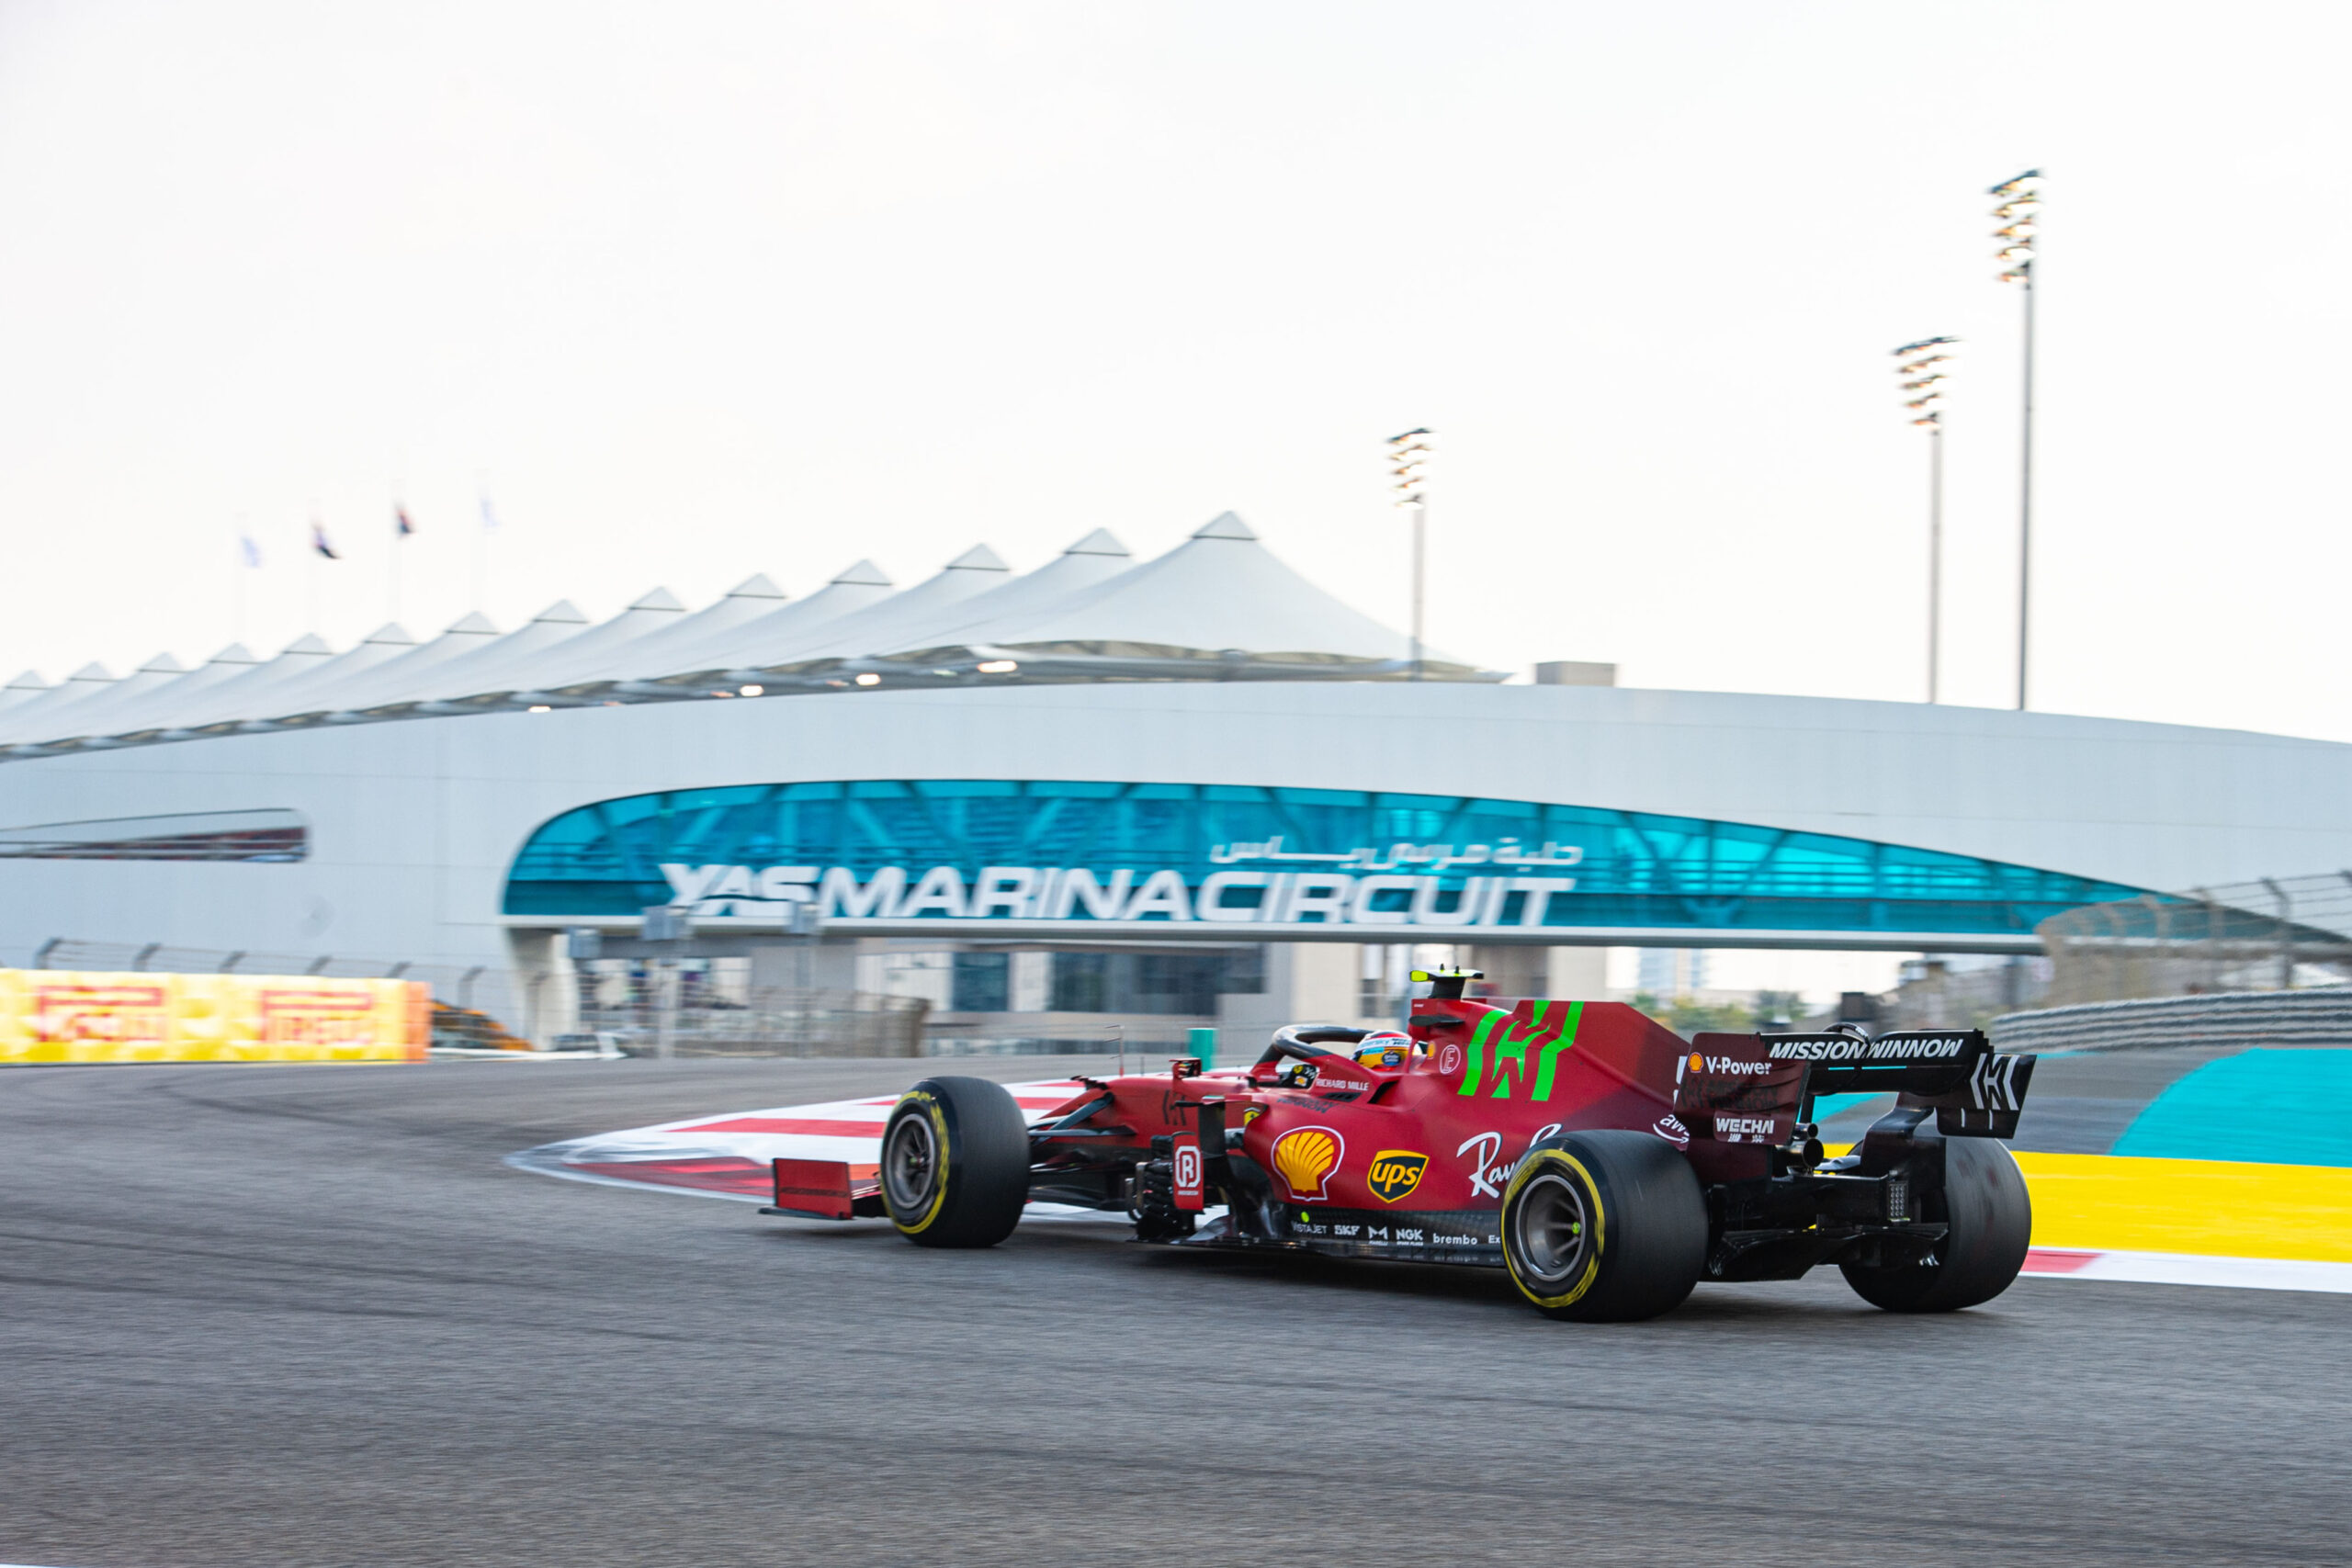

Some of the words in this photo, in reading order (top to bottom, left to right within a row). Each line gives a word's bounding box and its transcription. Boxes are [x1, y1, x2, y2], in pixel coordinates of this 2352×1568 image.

[1770, 1042, 1867, 1060] MISSION
[1866, 1039, 1963, 1058] WINNOW
[1705, 1055, 1772, 1075] V-Power
[1316, 1078, 1346, 1089] RICHARD
[1348, 1081, 1370, 1091] MILLE
[1372, 1162, 1420, 1193] ups
[1334, 1224, 1360, 1235] SKF
[1396, 1228, 1423, 1241] NGK
[1432, 1233, 1478, 1246] brembo
[1487, 1235, 1501, 1244] Ex
